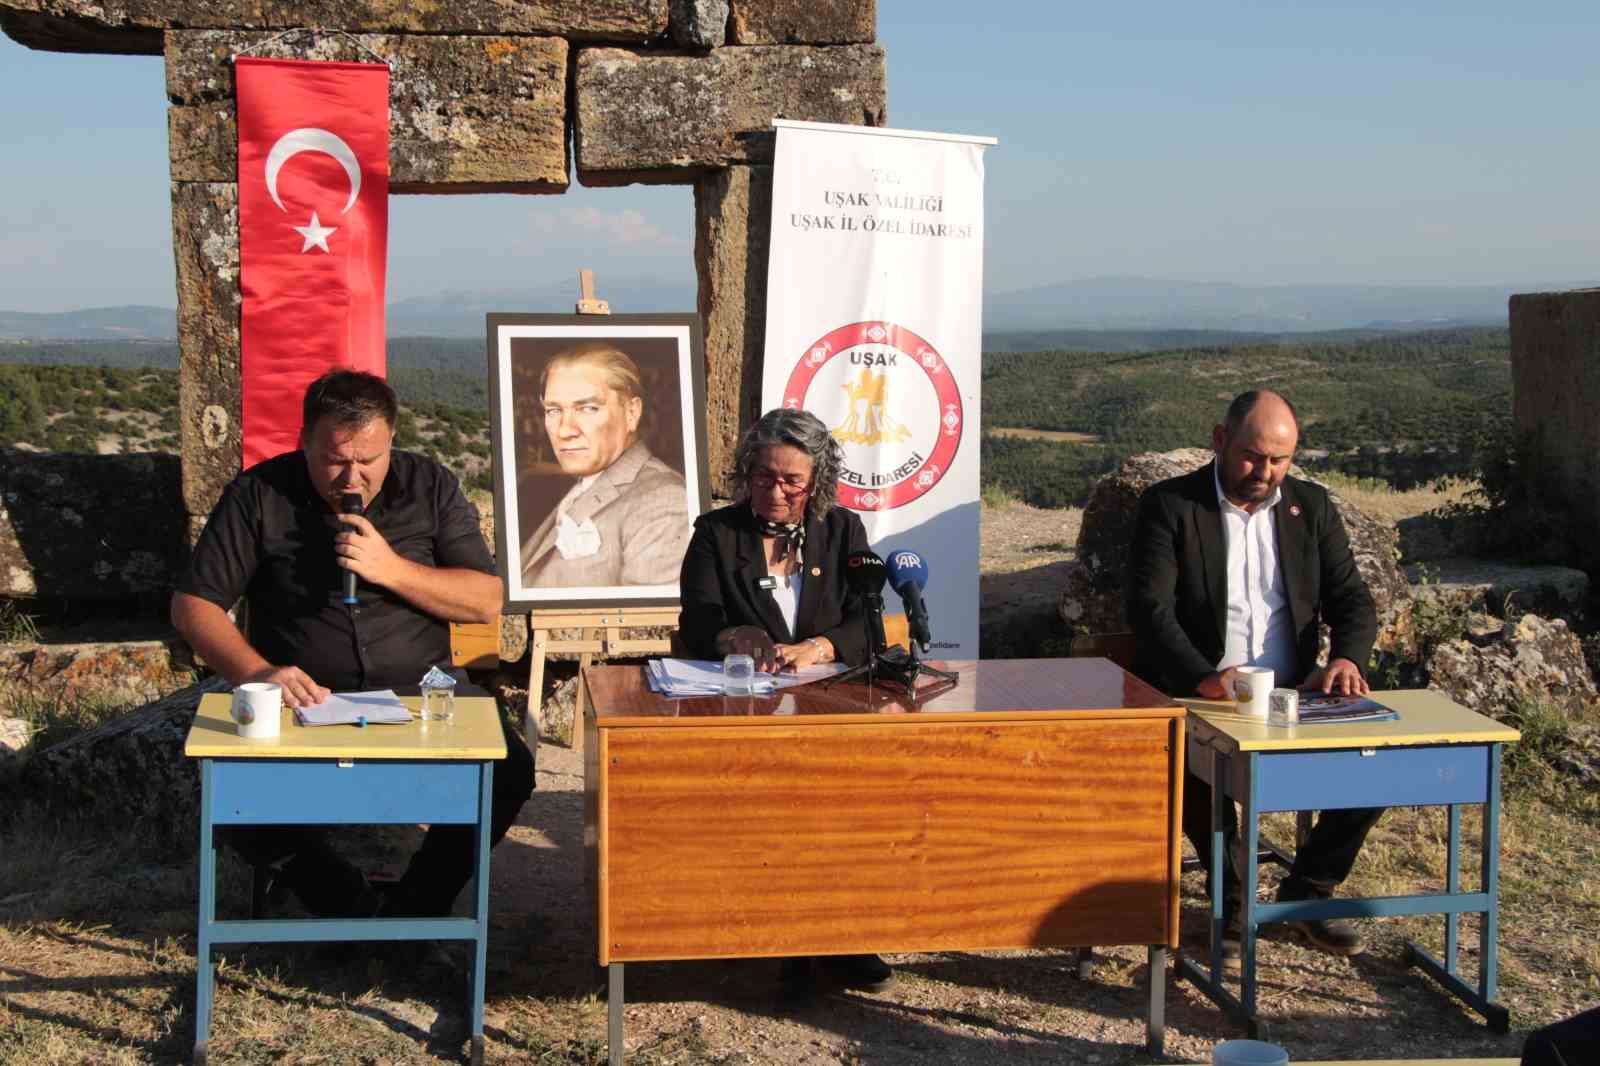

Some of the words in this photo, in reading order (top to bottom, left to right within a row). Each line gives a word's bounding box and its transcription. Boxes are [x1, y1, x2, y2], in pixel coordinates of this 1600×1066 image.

[824, 190, 869, 208] UŞAK
[874, 192, 943, 213] VALİLİĞİ
[791, 213, 835, 231] UŞAK
[841, 215, 858, 231] İL
[863, 215, 905, 234] ÖZEL
[909, 219, 973, 239] İDARESİ
[850, 351, 897, 368] UŞAK
[839, 466, 866, 486] ZEL
[871, 452, 924, 487] İDARESİ
